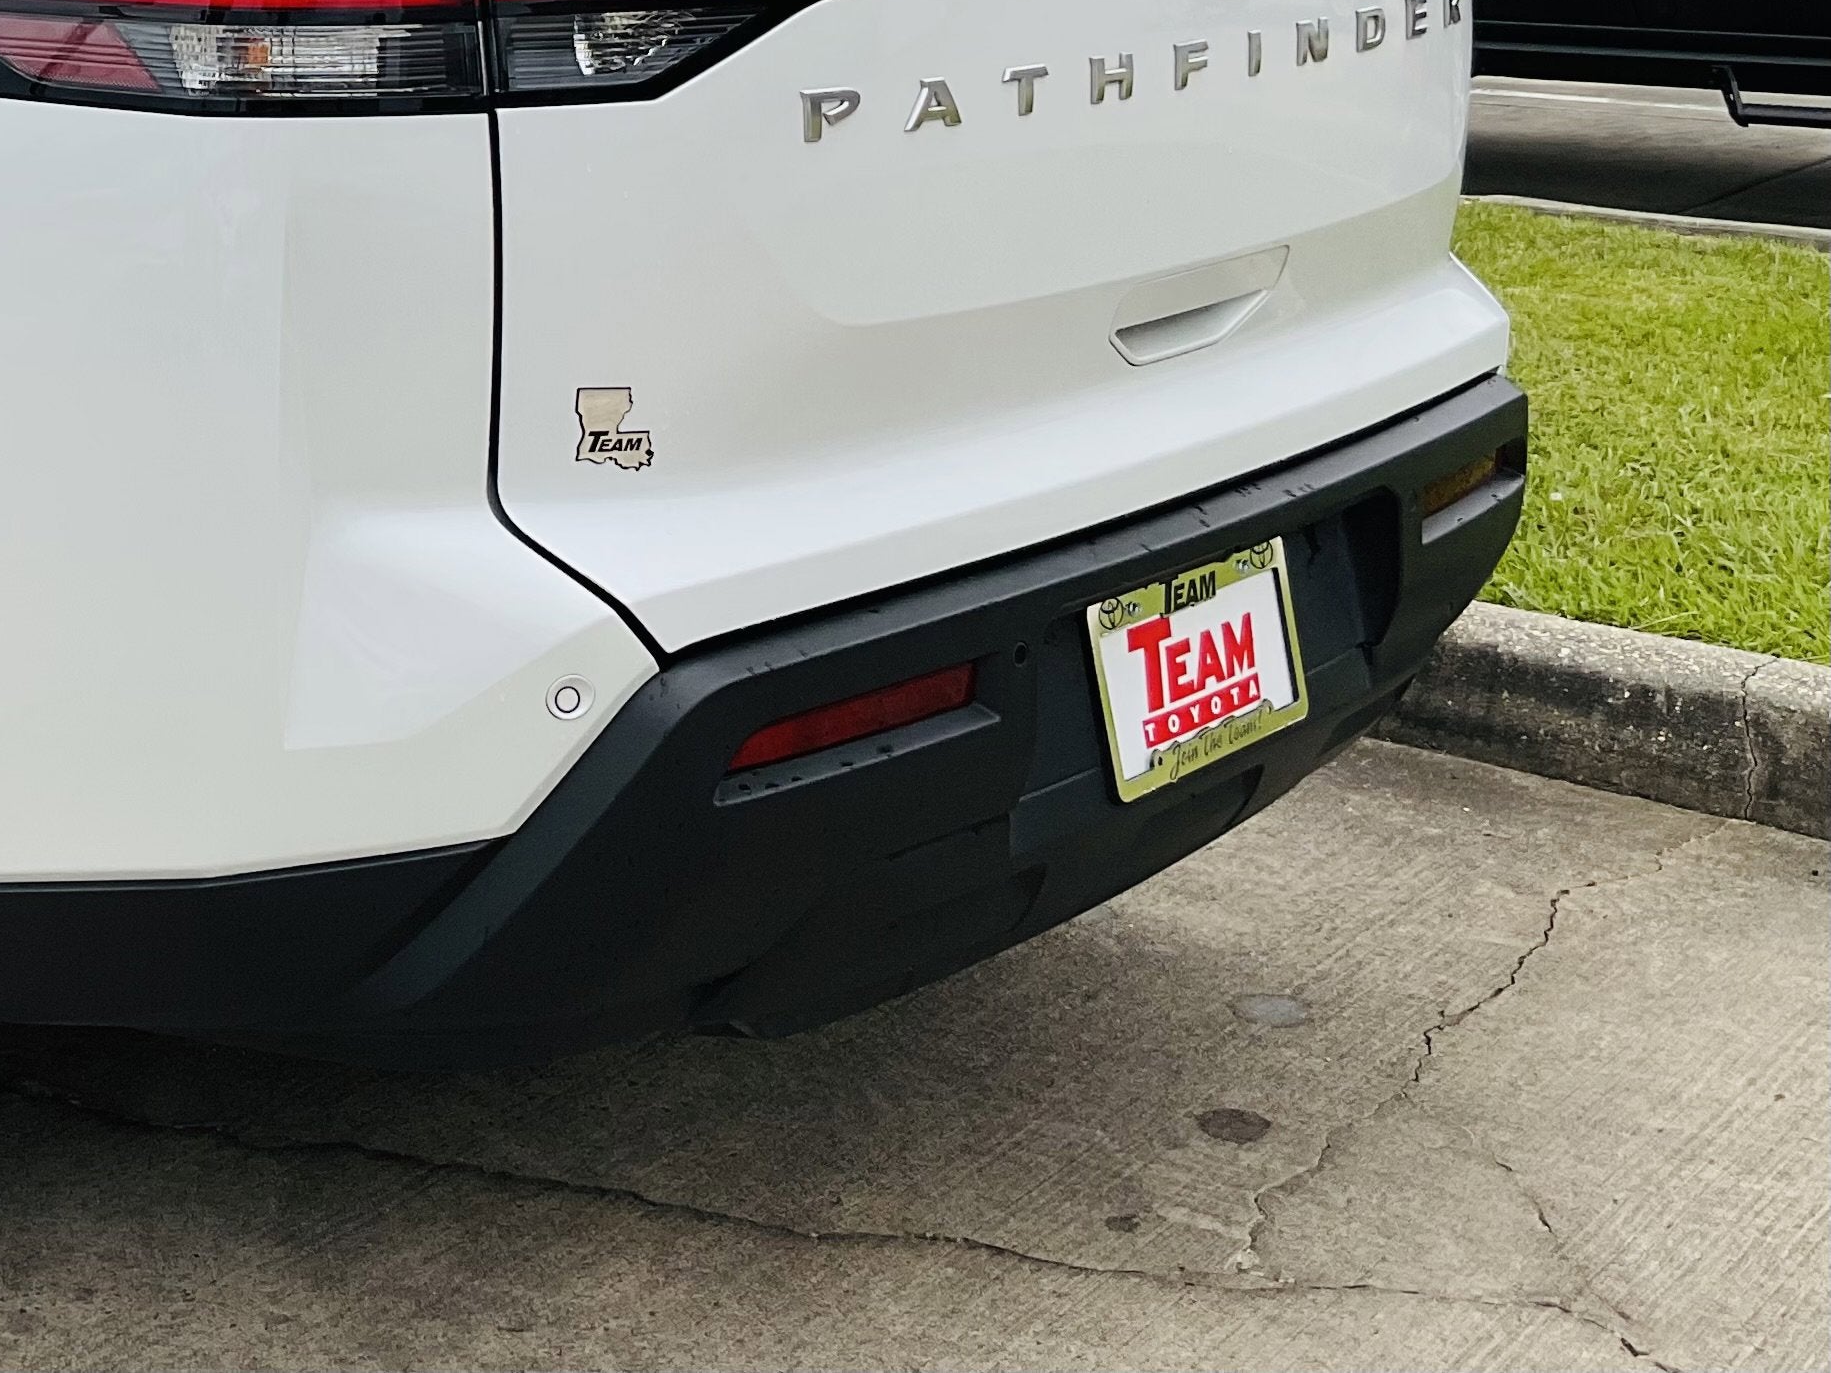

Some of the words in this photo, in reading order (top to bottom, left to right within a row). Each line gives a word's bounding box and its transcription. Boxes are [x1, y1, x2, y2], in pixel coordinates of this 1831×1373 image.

[588, 430, 643, 453] TEAM
[1158, 570, 1217, 619] TEAM
[1126, 611, 1256, 714] TEAM
[1144, 677, 1260, 743] TOYOTA
[1170, 743, 1199, 781] Join
[1199, 727, 1222, 756] The
